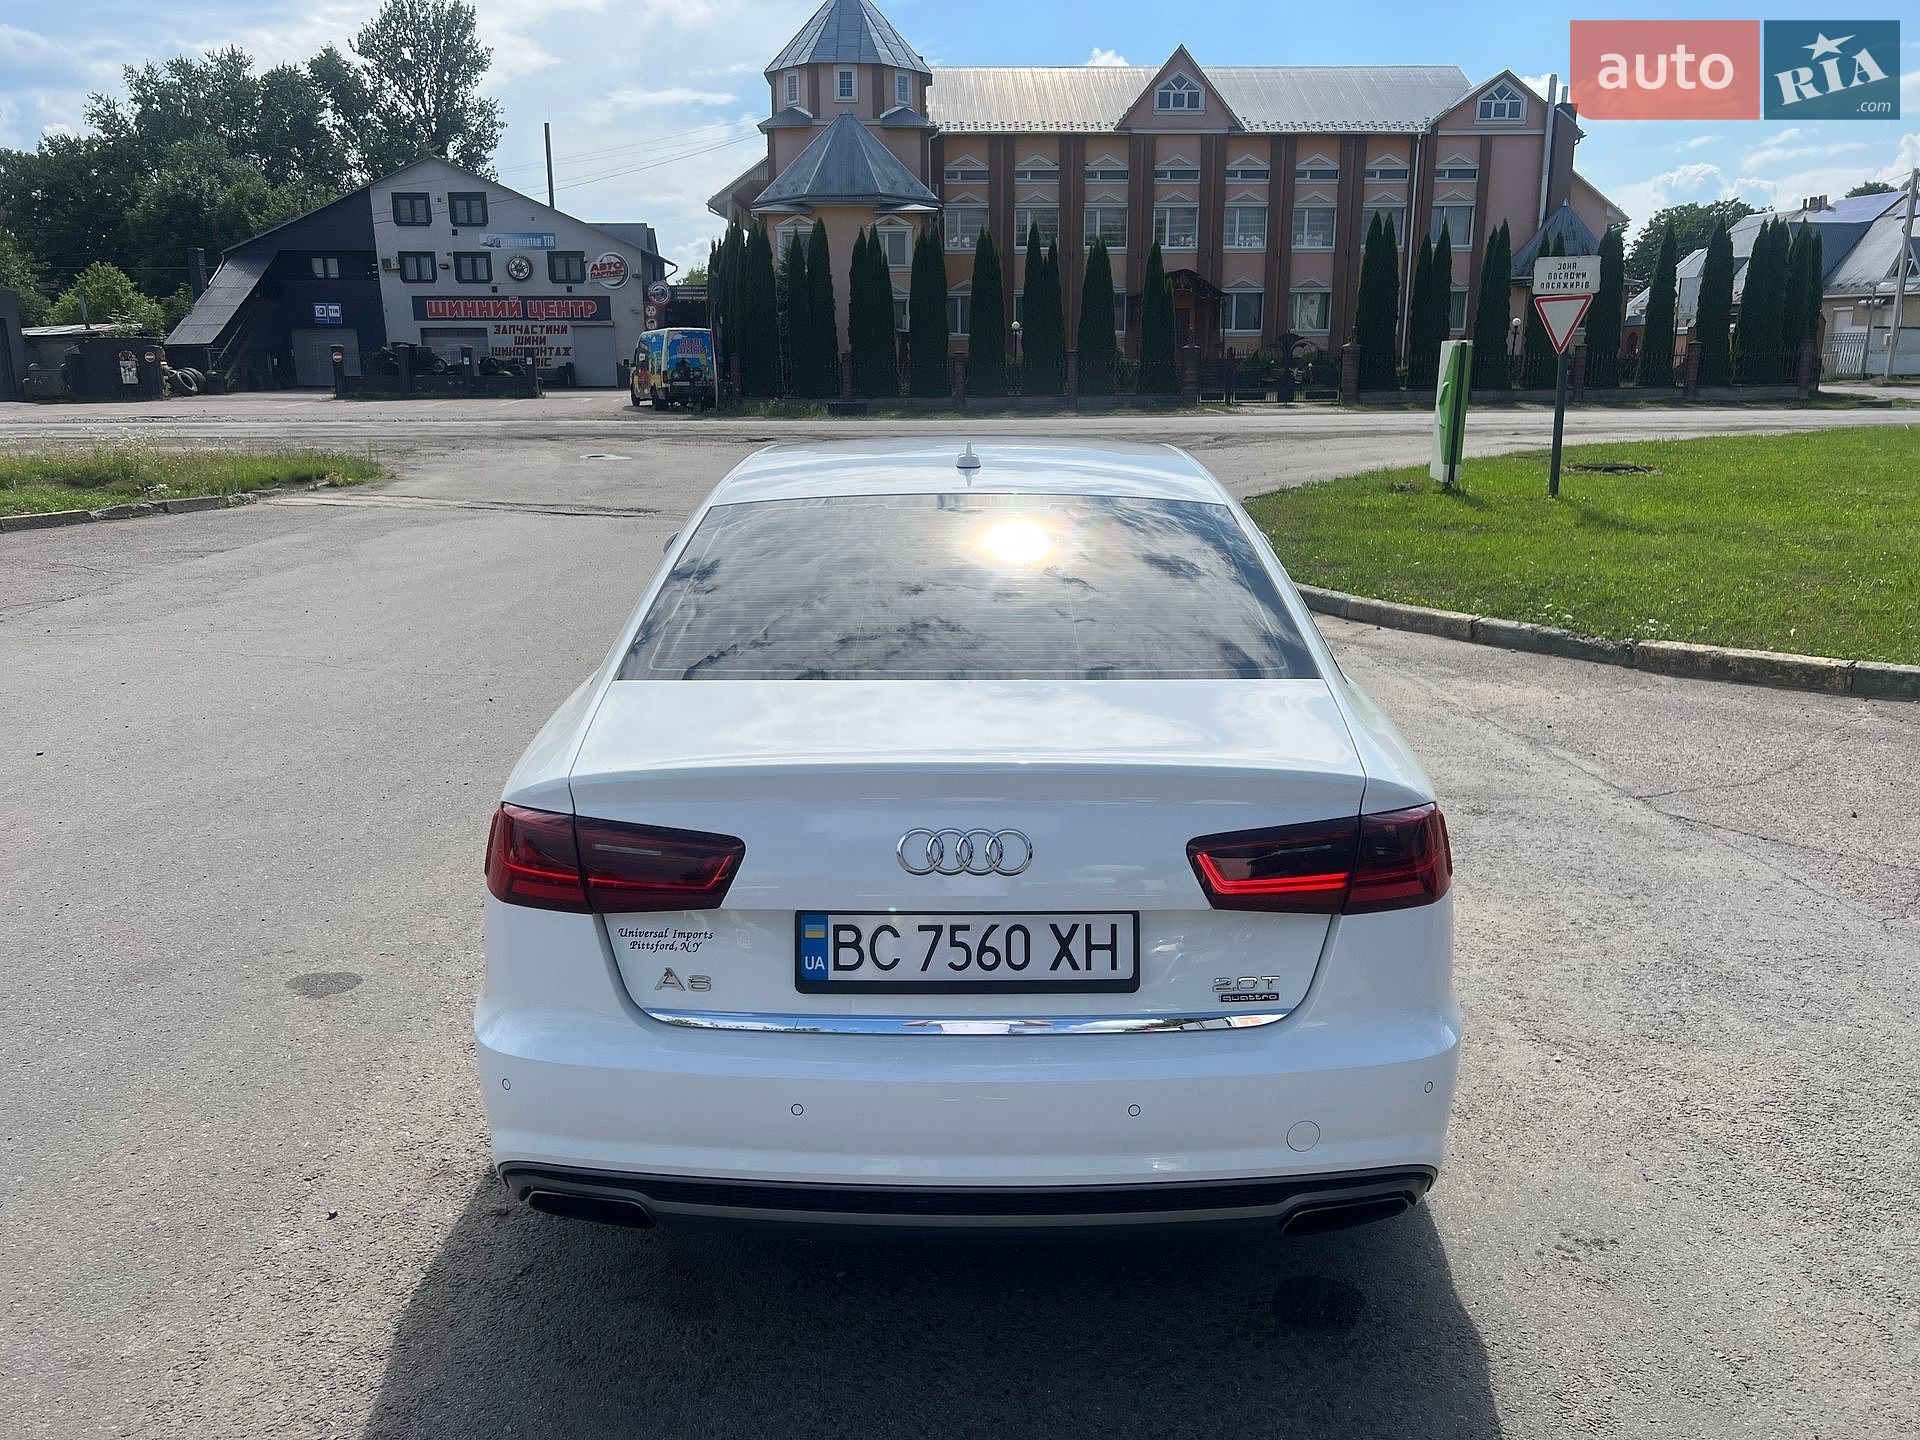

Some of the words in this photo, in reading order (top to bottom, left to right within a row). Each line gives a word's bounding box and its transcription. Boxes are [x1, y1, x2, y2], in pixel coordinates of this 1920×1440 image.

[591, 261, 624, 271] АВТО
[1557, 262, 1577, 270] ЗОНА
[1547, 271, 1587, 280] ПОСАДКИ
[1540, 280, 1590, 289] ПАСАЖИРІВ
[427, 297, 522, 318] ШИННИЙ
[527, 300, 598, 320] ЦЕНТР
[494, 325, 568, 334] ЗАПЧАСТИНИ
[514, 336, 546, 345] ШИНИ
[492, 347, 571, 356] ШИНООНТАЖ
[618, 928, 670, 938] Universal
[672, 930, 714, 941] Imports
[629, 940, 678, 953] Pittsford,
[833, 924, 901, 971] BC
[917, 924, 1031, 971] 7560
[1049, 923, 1117, 970] XH
[805, 956, 825, 970] UA
[655, 967, 712, 993] A6
[1213, 976, 1280, 992] 2.0T
[1222, 994, 1278, 1002] quattro
